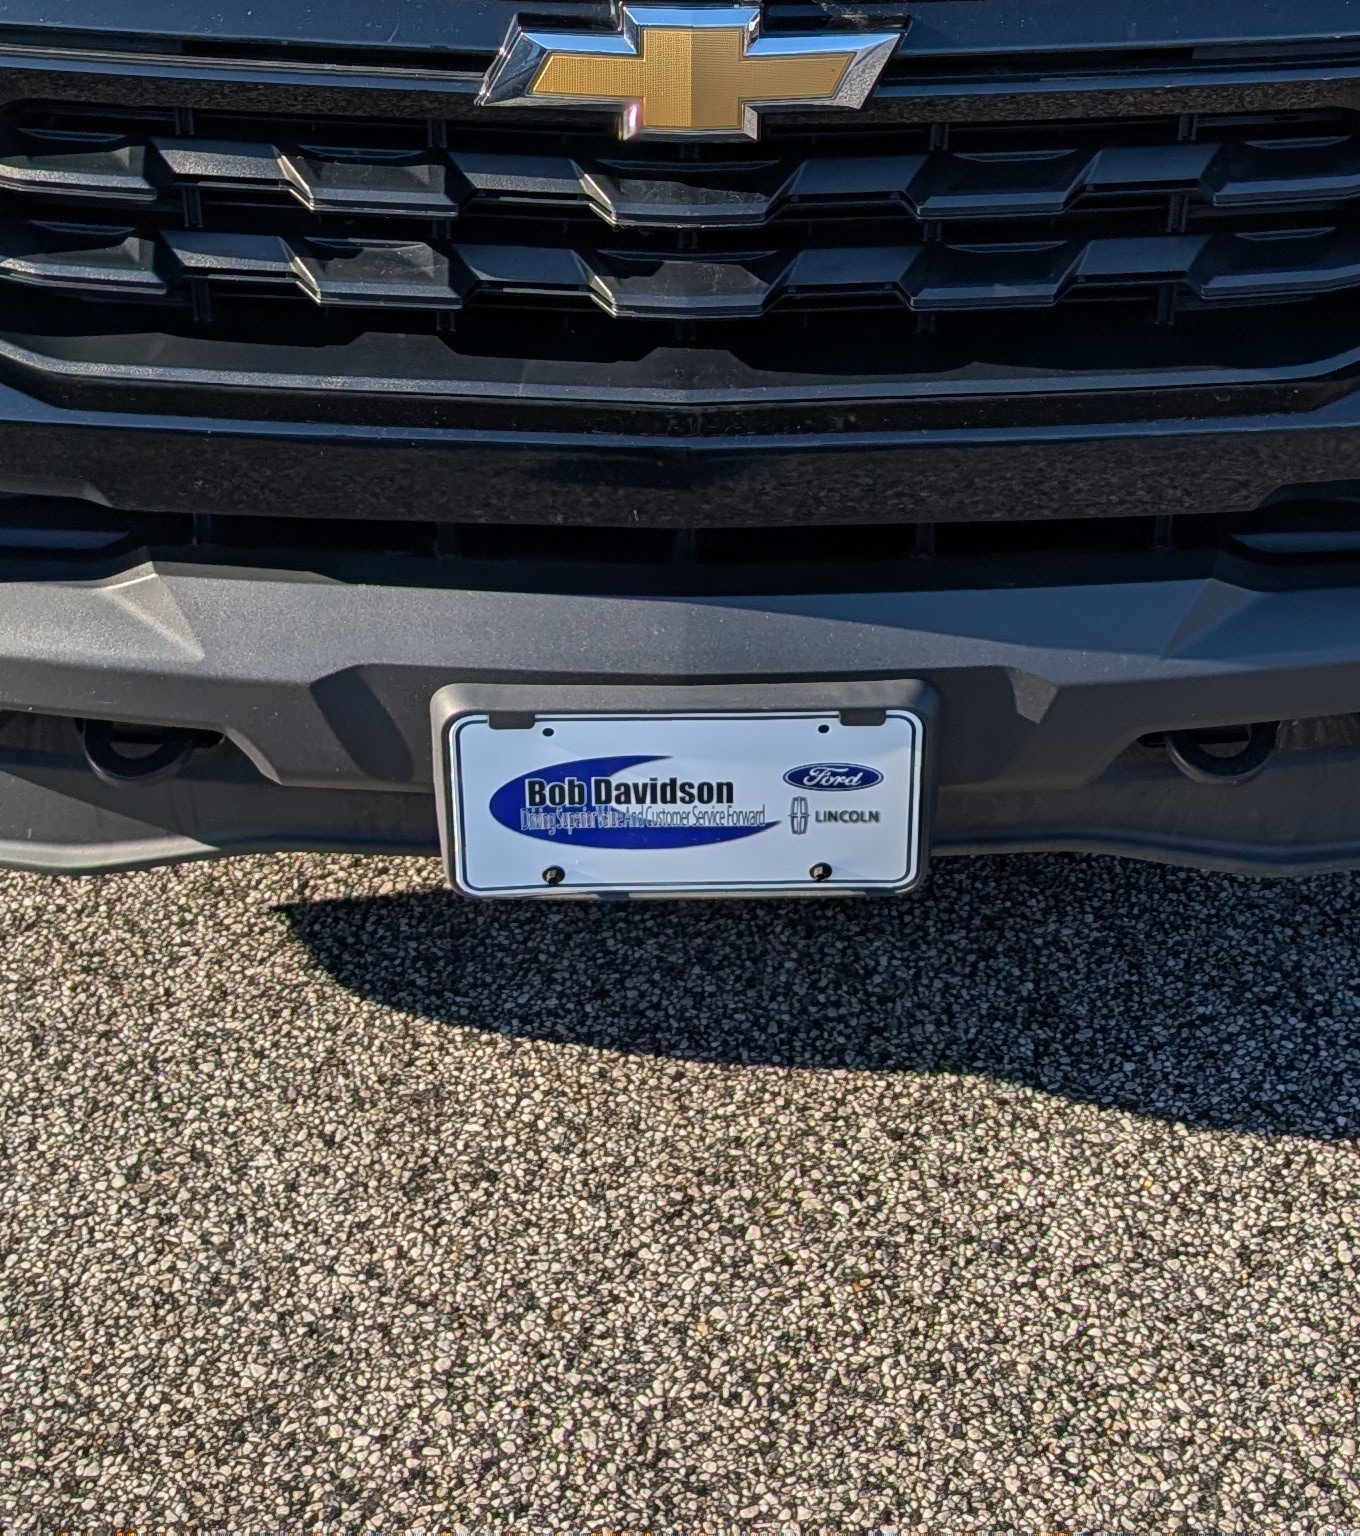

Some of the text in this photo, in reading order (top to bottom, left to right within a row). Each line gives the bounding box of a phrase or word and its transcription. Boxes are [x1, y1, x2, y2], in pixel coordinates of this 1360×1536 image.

[803, 767, 864, 786] Ford
[526, 776, 735, 807] Bob Davidson
[521, 807, 557, 835] Driving
[556, 806, 596, 835] Superior
[644, 805, 692, 827] Customer
[691, 804, 726, 826] Service
[726, 803, 766, 826] Forward
[815, 810, 880, 823] LINCOLN
